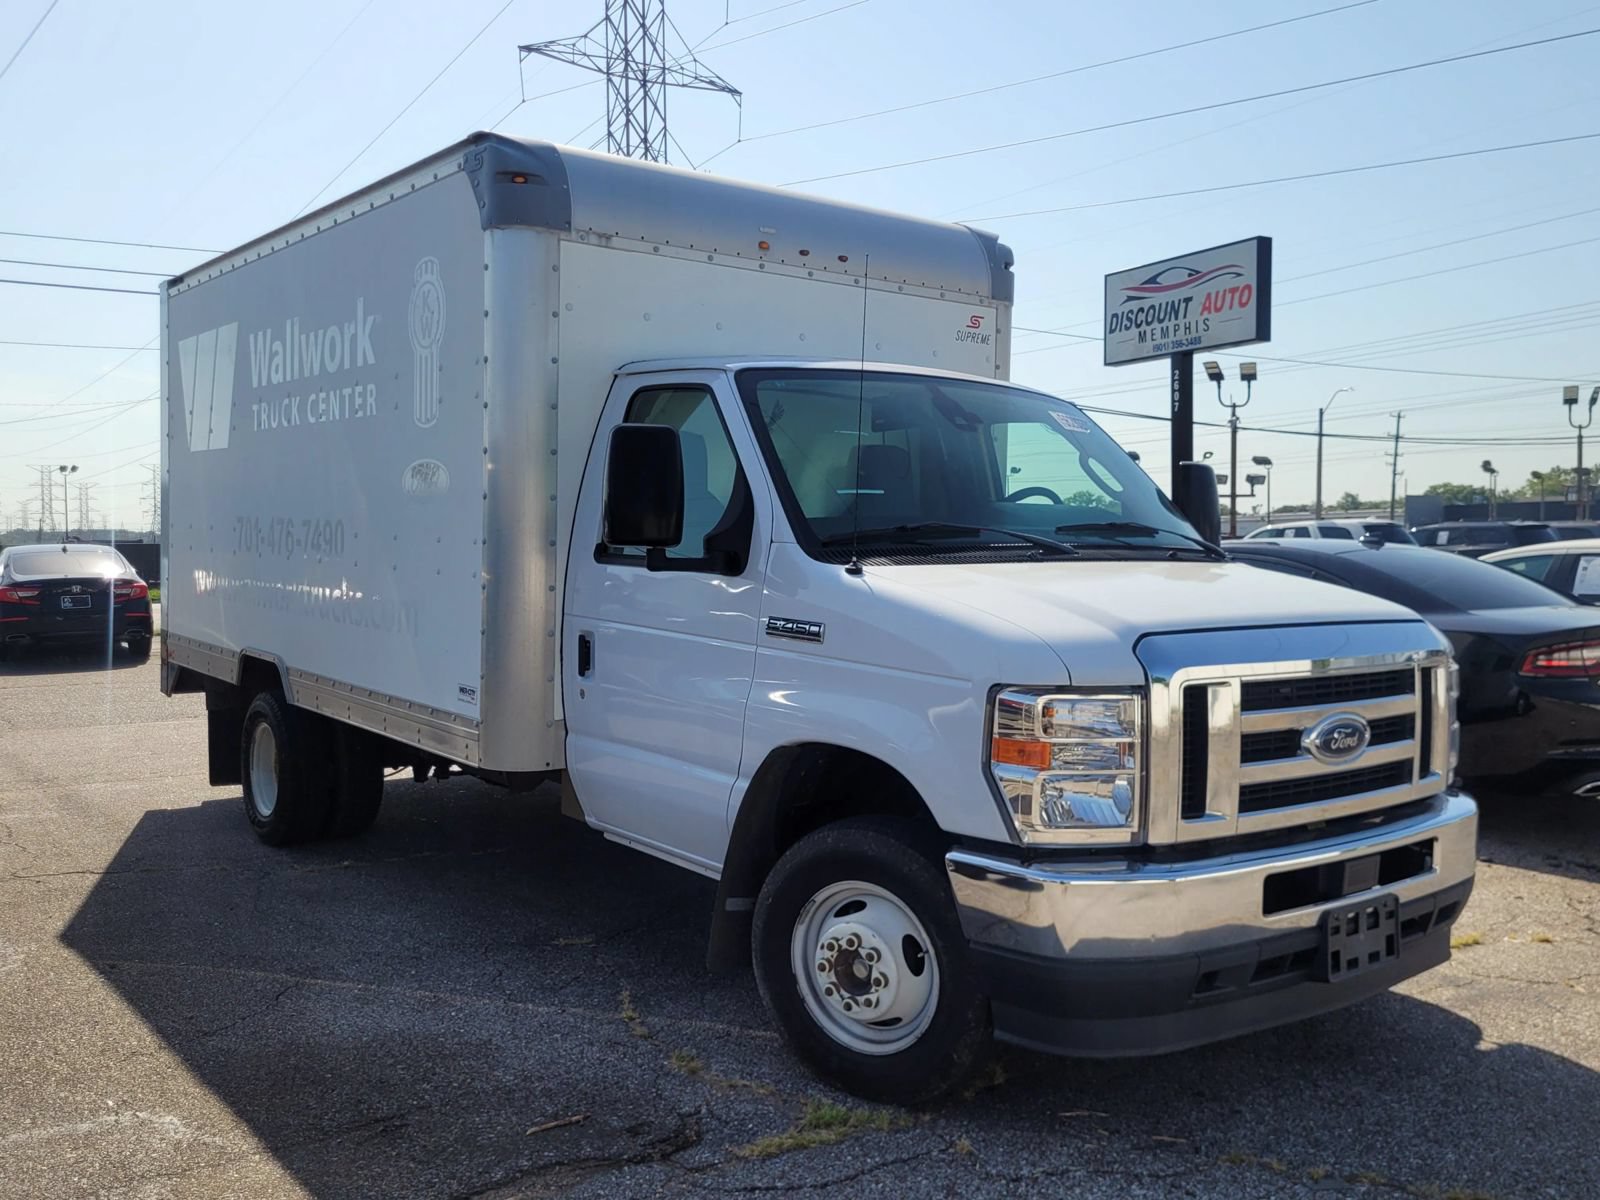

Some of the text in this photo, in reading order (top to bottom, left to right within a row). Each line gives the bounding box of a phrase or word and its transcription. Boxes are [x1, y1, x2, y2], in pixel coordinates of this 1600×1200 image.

[1108, 283, 1253, 335] DISCOUNT AUTO
[249, 296, 376, 389] Wallwork
[955, 330, 992, 346] SUPREME
[1138, 318, 1210, 344] MEMPHIS
[252, 383, 377, 432] TRUCK CENTER
[1330, 727, 1360, 750] Ford
